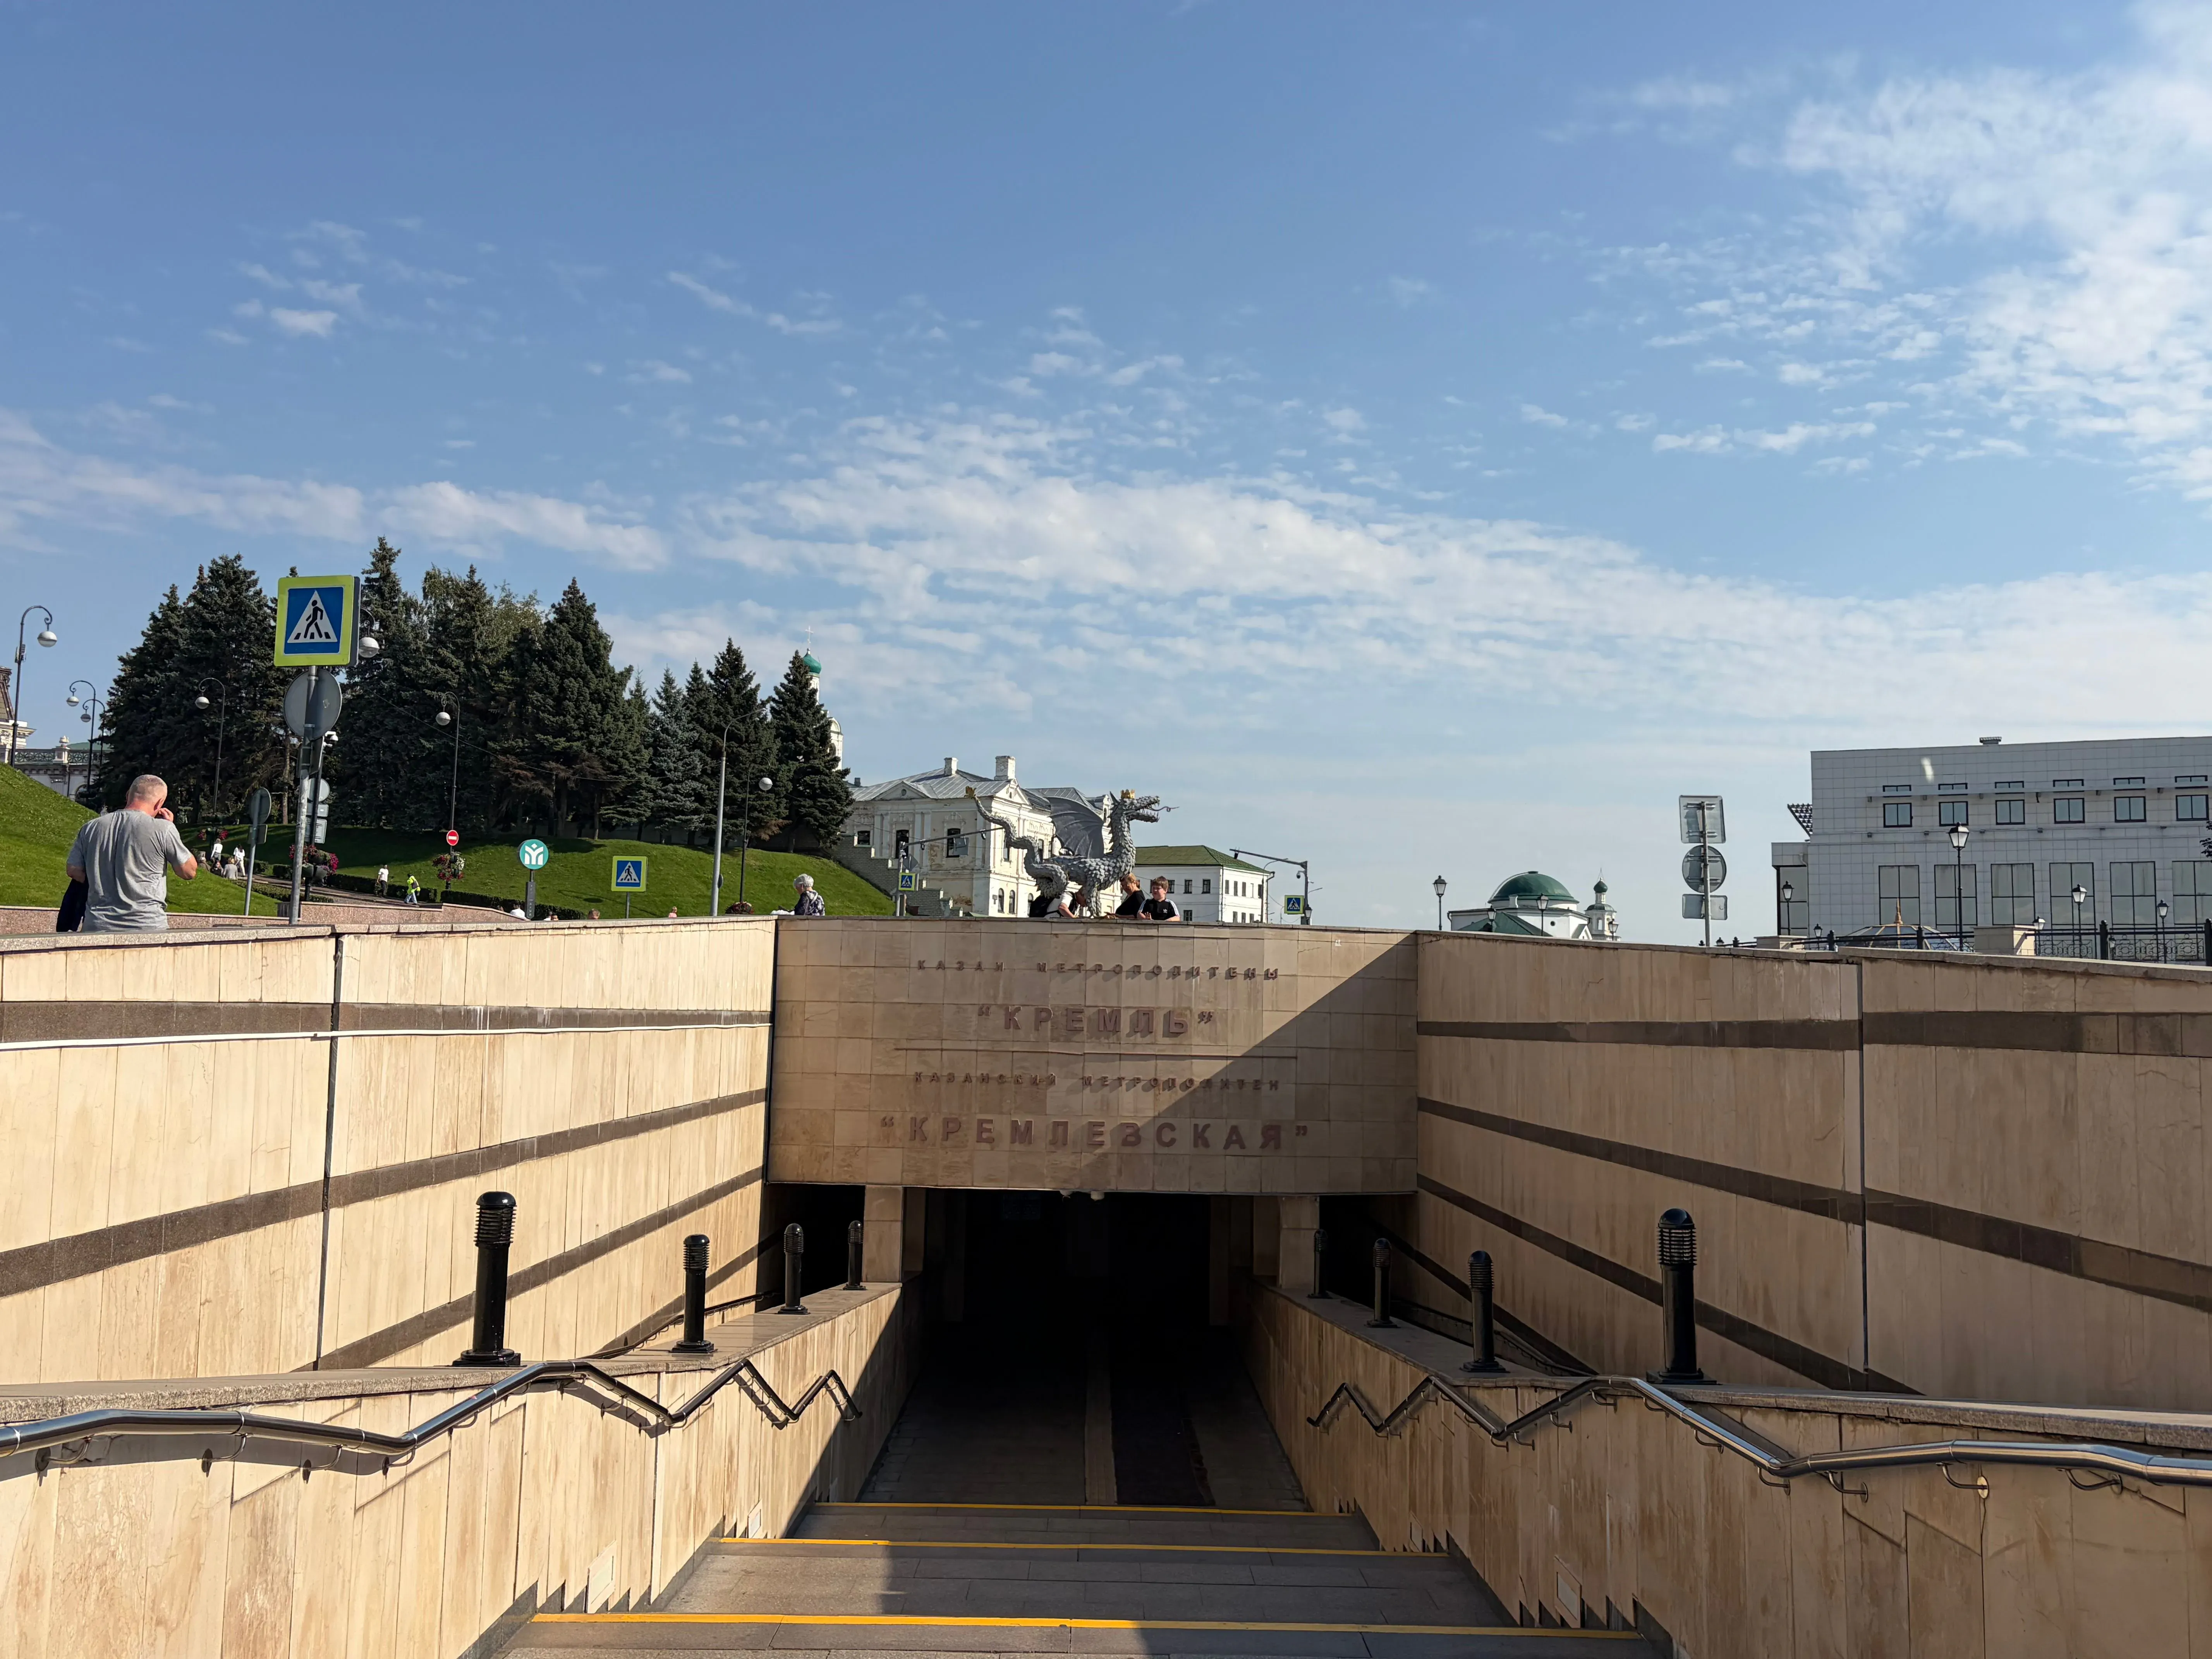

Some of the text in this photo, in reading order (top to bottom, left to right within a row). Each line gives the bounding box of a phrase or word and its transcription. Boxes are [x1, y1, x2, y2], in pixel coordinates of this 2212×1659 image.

[917, 960, 1278, 979] КАЗАН МЕТРОПОЛИТЕНЫ
[915, 1072, 1279, 1090] КАЗАНСКИЙ МЕТРОПОЛИТЕН
